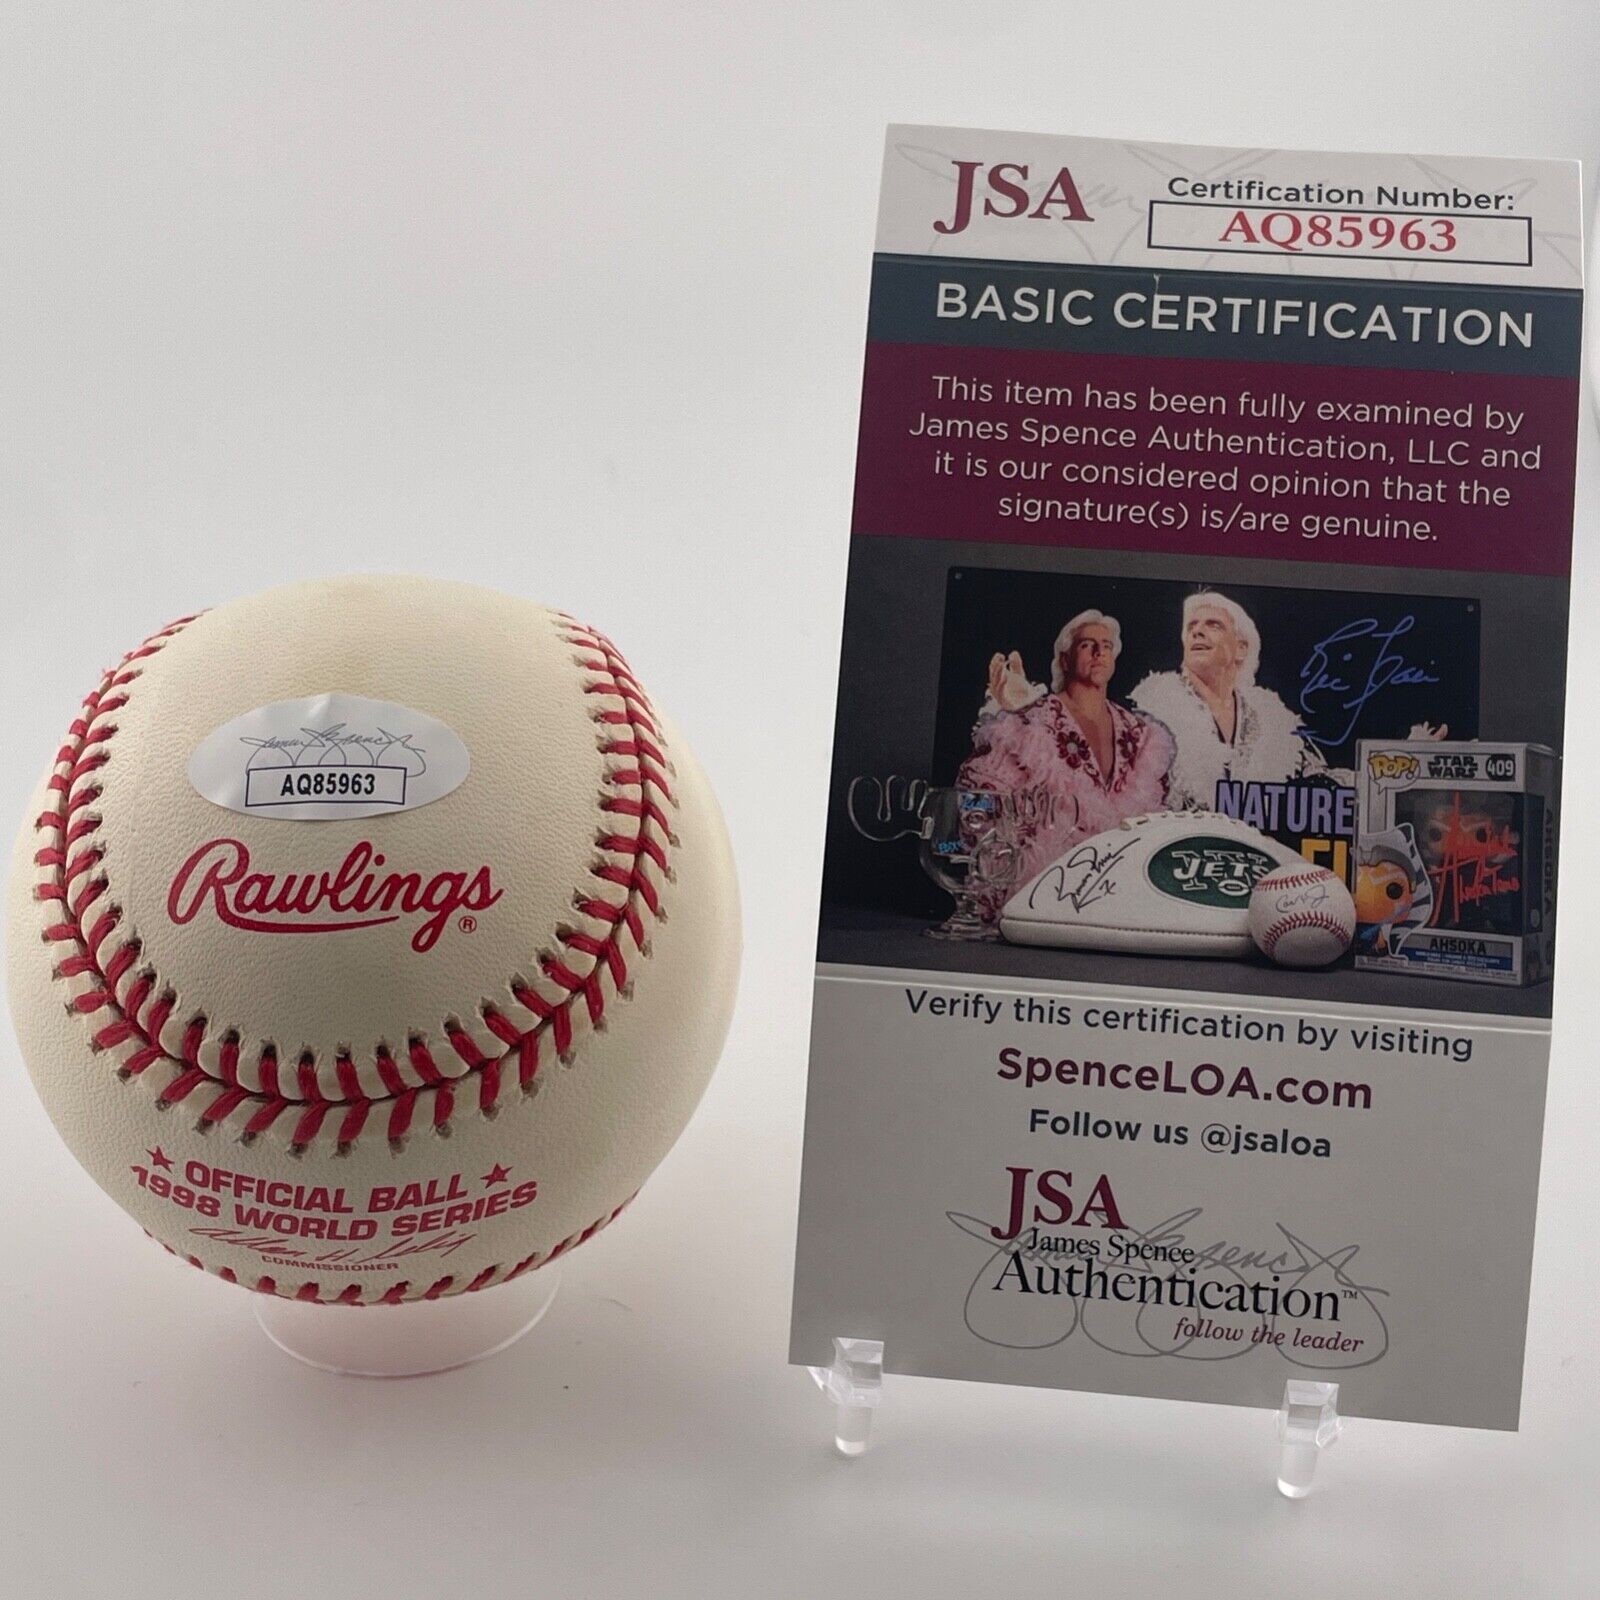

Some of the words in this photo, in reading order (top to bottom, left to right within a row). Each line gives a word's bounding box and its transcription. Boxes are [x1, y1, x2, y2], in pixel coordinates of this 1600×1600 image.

[933, 160, 1095, 234] JSA
[1167, 176, 1364, 205] Certification
[1376, 186, 1515, 210] Number:
[1218, 210, 1457, 252] AQ85963
[936, 282, 1095, 326] BASIC
[1113, 293, 1535, 348] CERTIFICATION
[932, 376, 994, 403] This
[1005, 380, 1073, 407] item
[1084, 383, 1138, 411] has
[1150, 387, 1226, 415] been
[1238, 391, 1306, 424] fully
[1316, 400, 1473, 428] examined
[1485, 404, 1524, 435] by
[909, 412, 1009, 441] James
[1020, 418, 1137, 447] Spence
[1148, 426, 1395, 465] Authentication,
[1408, 438, 1470, 466] LLC
[1481, 445, 1541, 470] and
[934, 450, 954, 476] it
[965, 452, 988, 477] is
[999, 460, 1052, 481] our
[1062, 462, 1238, 492] considered
[1250, 472, 1370, 499] opinion
[1382, 475, 1448, 503] that
[1459, 480, 1511, 506] the
[998, 492, 1189, 530] signature(s)
[1201, 502, 1290, 533] is/are
[1301, 514, 1438, 541] genuine.
[280, 773, 376, 797] AQ85963
[1368, 754, 1419, 779] POP!
[1428, 755, 1478, 767] STAR
[1428, 766, 1478, 779] WARS
[1486, 758, 1516, 777] 409
[1218, 780, 1355, 835] NATURE
[167, 838, 504, 953] Rawlings
[1429, 937, 1487, 956] AHSOKA
[906, 989, 1002, 1024] Verify
[1014, 998, 1071, 1025] this
[1083, 1007, 1284, 1042] certification
[1297, 1019, 1338, 1051] by
[1350, 1025, 1473, 1062] visiting
[997, 1048, 1372, 1109] SpenceLOA.com
[1029, 1108, 1141, 1141] Follow
[1153, 1124, 1189, 1145] us
[1201, 1123, 1331, 1157] @jsaloa
[131, 1165, 220, 1217] 1998
[234, 1203, 388, 1241] WORLD
[390, 1181, 538, 1237] SERIES
[185, 1160, 353, 1214] OFFICIAL
[368, 1173, 468, 1214] BALL
[991, 1167, 1129, 1240] JSA
[261, 1254, 399, 1272] COMMISSIONER
[1027, 1227, 1100, 1257] James
[1107, 1234, 1195, 1264] Spence
[992, 1250, 1341, 1321] Authentication
[1174, 1317, 1243, 1343] follow
[1252, 1325, 1284, 1346] the
[1292, 1325, 1364, 1353] leader
